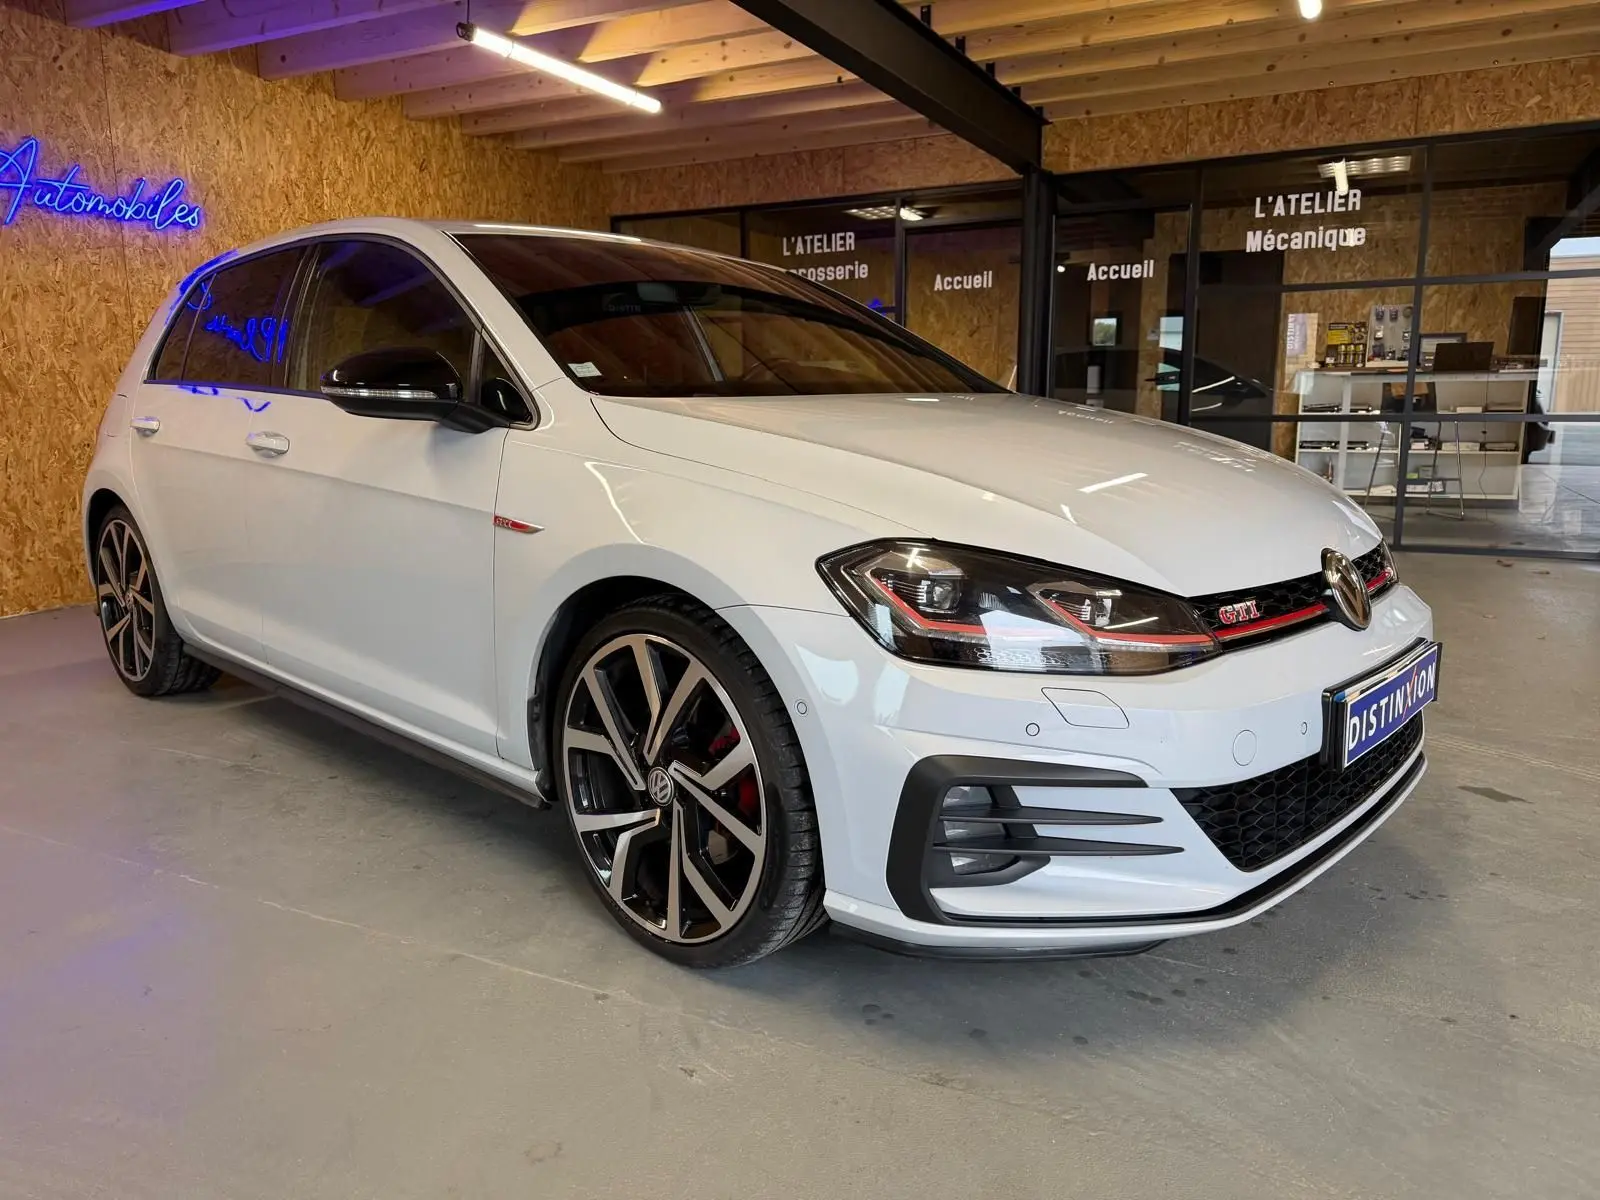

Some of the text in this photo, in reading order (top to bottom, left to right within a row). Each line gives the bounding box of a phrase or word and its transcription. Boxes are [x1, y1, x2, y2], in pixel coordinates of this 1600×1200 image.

[1254, 188, 1362, 219] L'ATELIER
[782, 231, 856, 257] L'ATELIER
[1245, 225, 1367, 253] Mécanique
[788, 260, 869, 283] rosserie
[933, 270, 993, 292] Accueil
[1086, 259, 1155, 281] Accueil
[1218, 599, 1261, 625] GTI
[1349, 660, 1437, 751] DISTINXION
